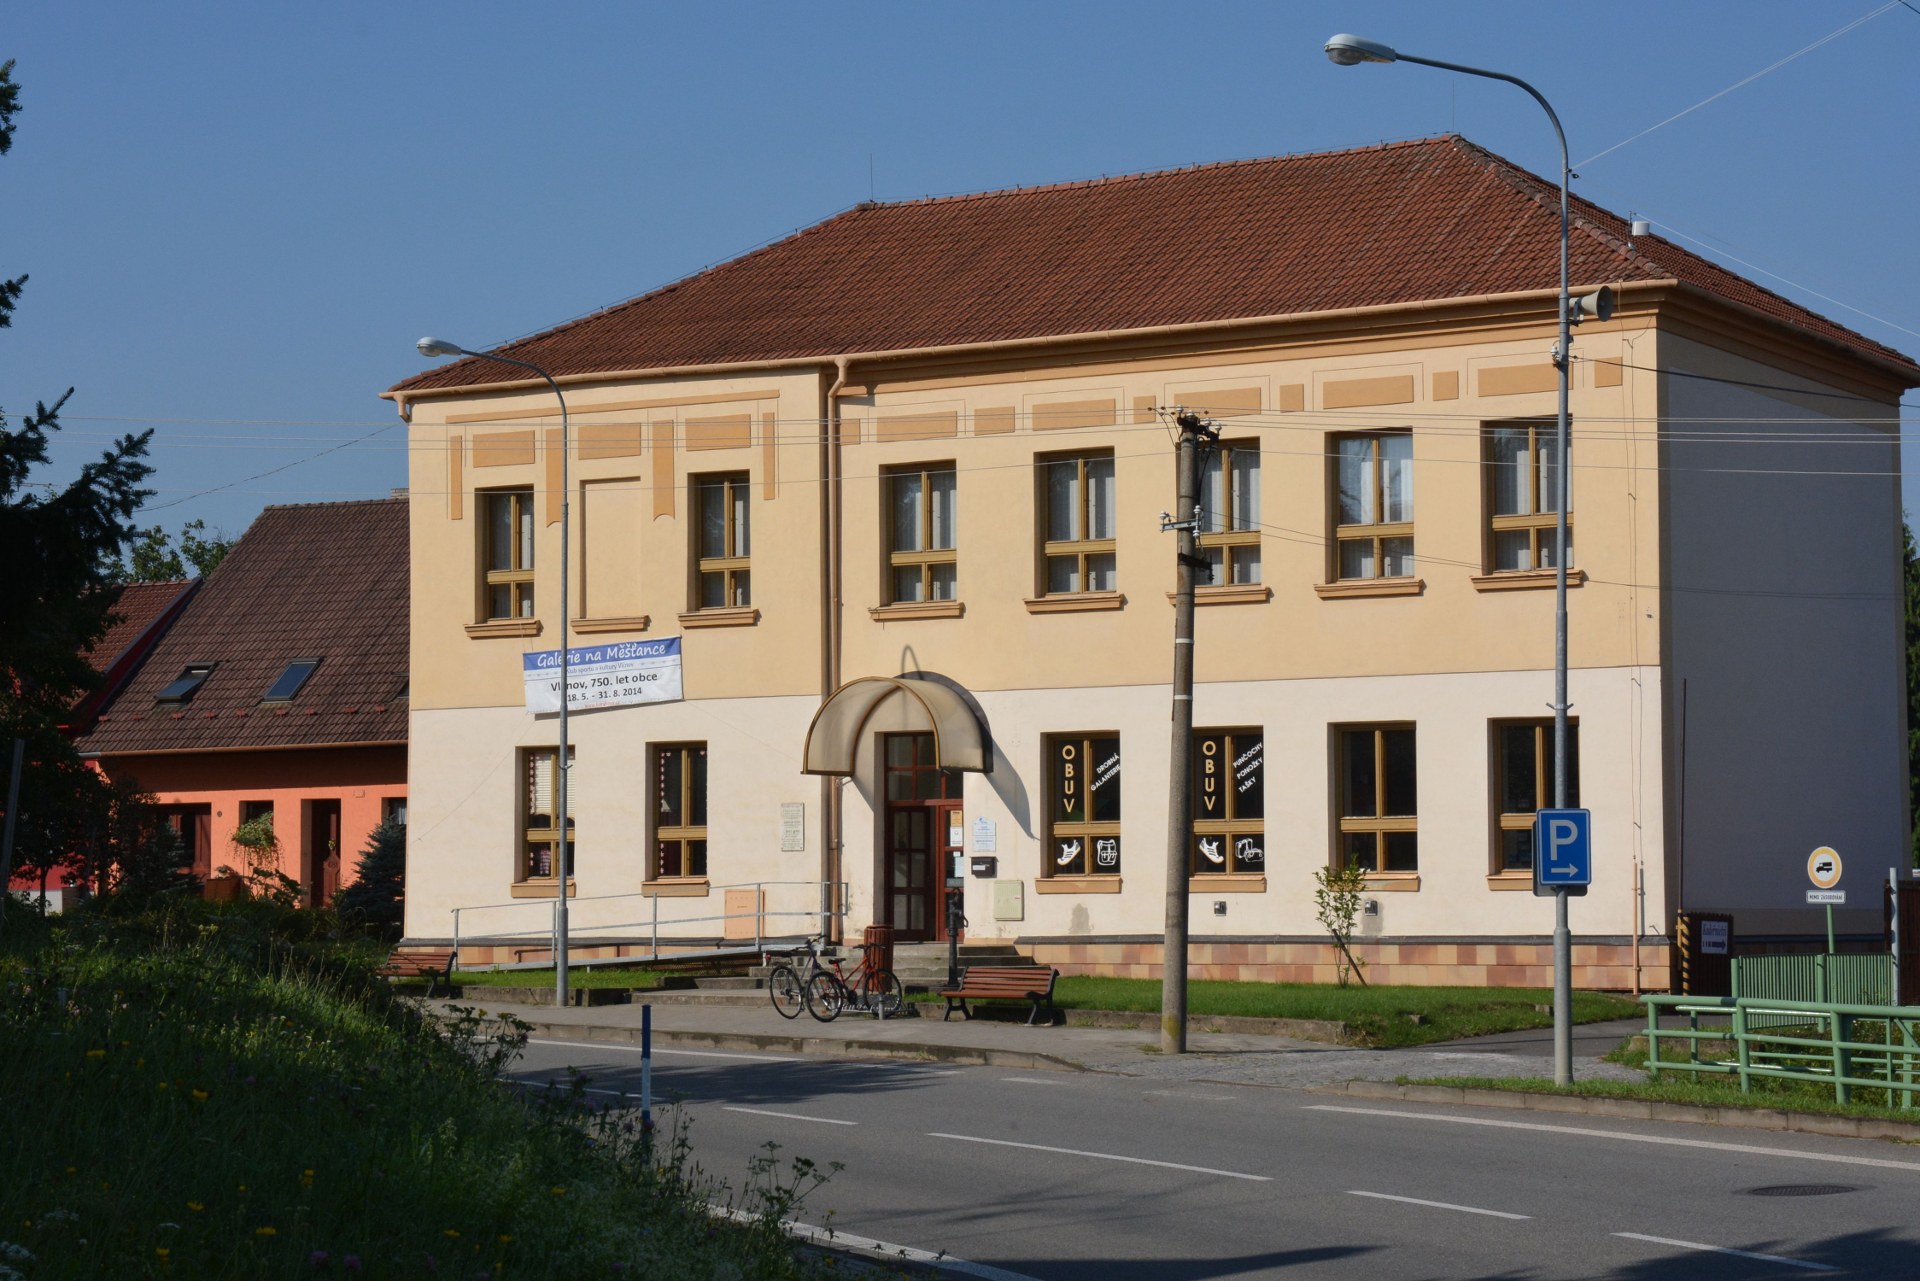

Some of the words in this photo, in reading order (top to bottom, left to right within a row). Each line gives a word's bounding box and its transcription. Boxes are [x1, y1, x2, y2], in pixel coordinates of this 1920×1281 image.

[585, 651, 602, 662] na
[606, 643, 666, 659] Měšťance
[578, 666, 594, 674] sportu
[551, 681, 587, 691] Vlnov,
[591, 677, 613, 688] 750.
[616, 675, 629, 685] let
[632, 673, 658, 683] obce
[567, 693, 579, 702] 18.
[581, 693, 589, 701] 5.
[598, 690, 611, 699] 31.
[613, 689, 620, 698] 8.
[622, 687, 642, 696] 2014
[1096, 752, 1120, 774] DROBNÁ
[1232, 741, 1263, 768] PUNČOCHY
[1062, 744, 1075, 813] OBUV
[1202, 740, 1216, 811] OBUV
[1236, 756, 1263, 780] PONOŽKY
[1238, 776, 1256, 793] TAŠKY
[1550, 820, 1578, 860] P
